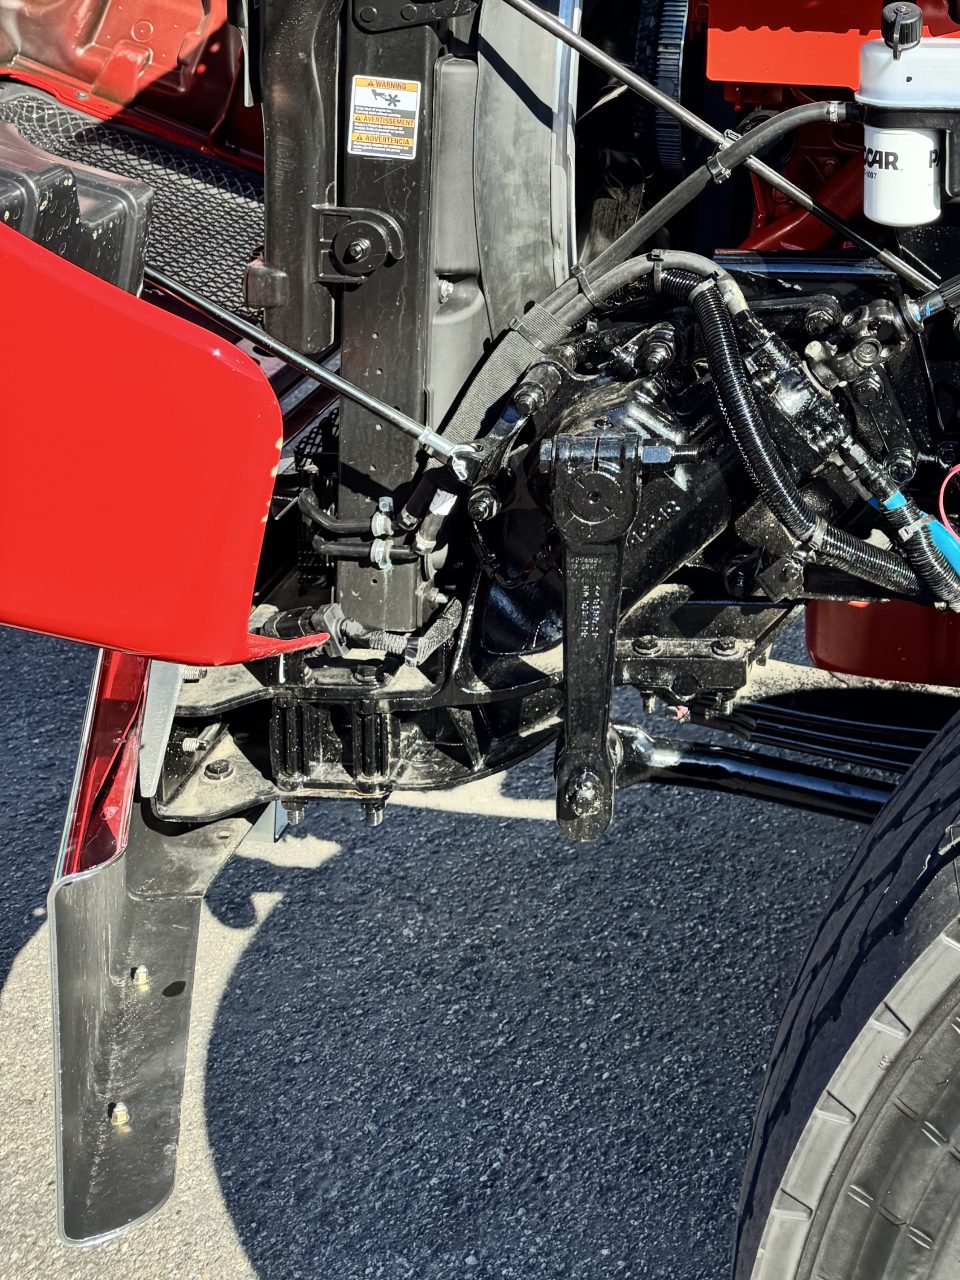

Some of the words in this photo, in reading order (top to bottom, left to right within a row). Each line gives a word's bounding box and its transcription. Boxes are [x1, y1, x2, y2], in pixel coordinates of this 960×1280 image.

[375, 80, 407, 90] WARNING
[363, 115, 414, 127] AVERTISSEMENT
[365, 135, 410, 145] ADVERTENCIA
